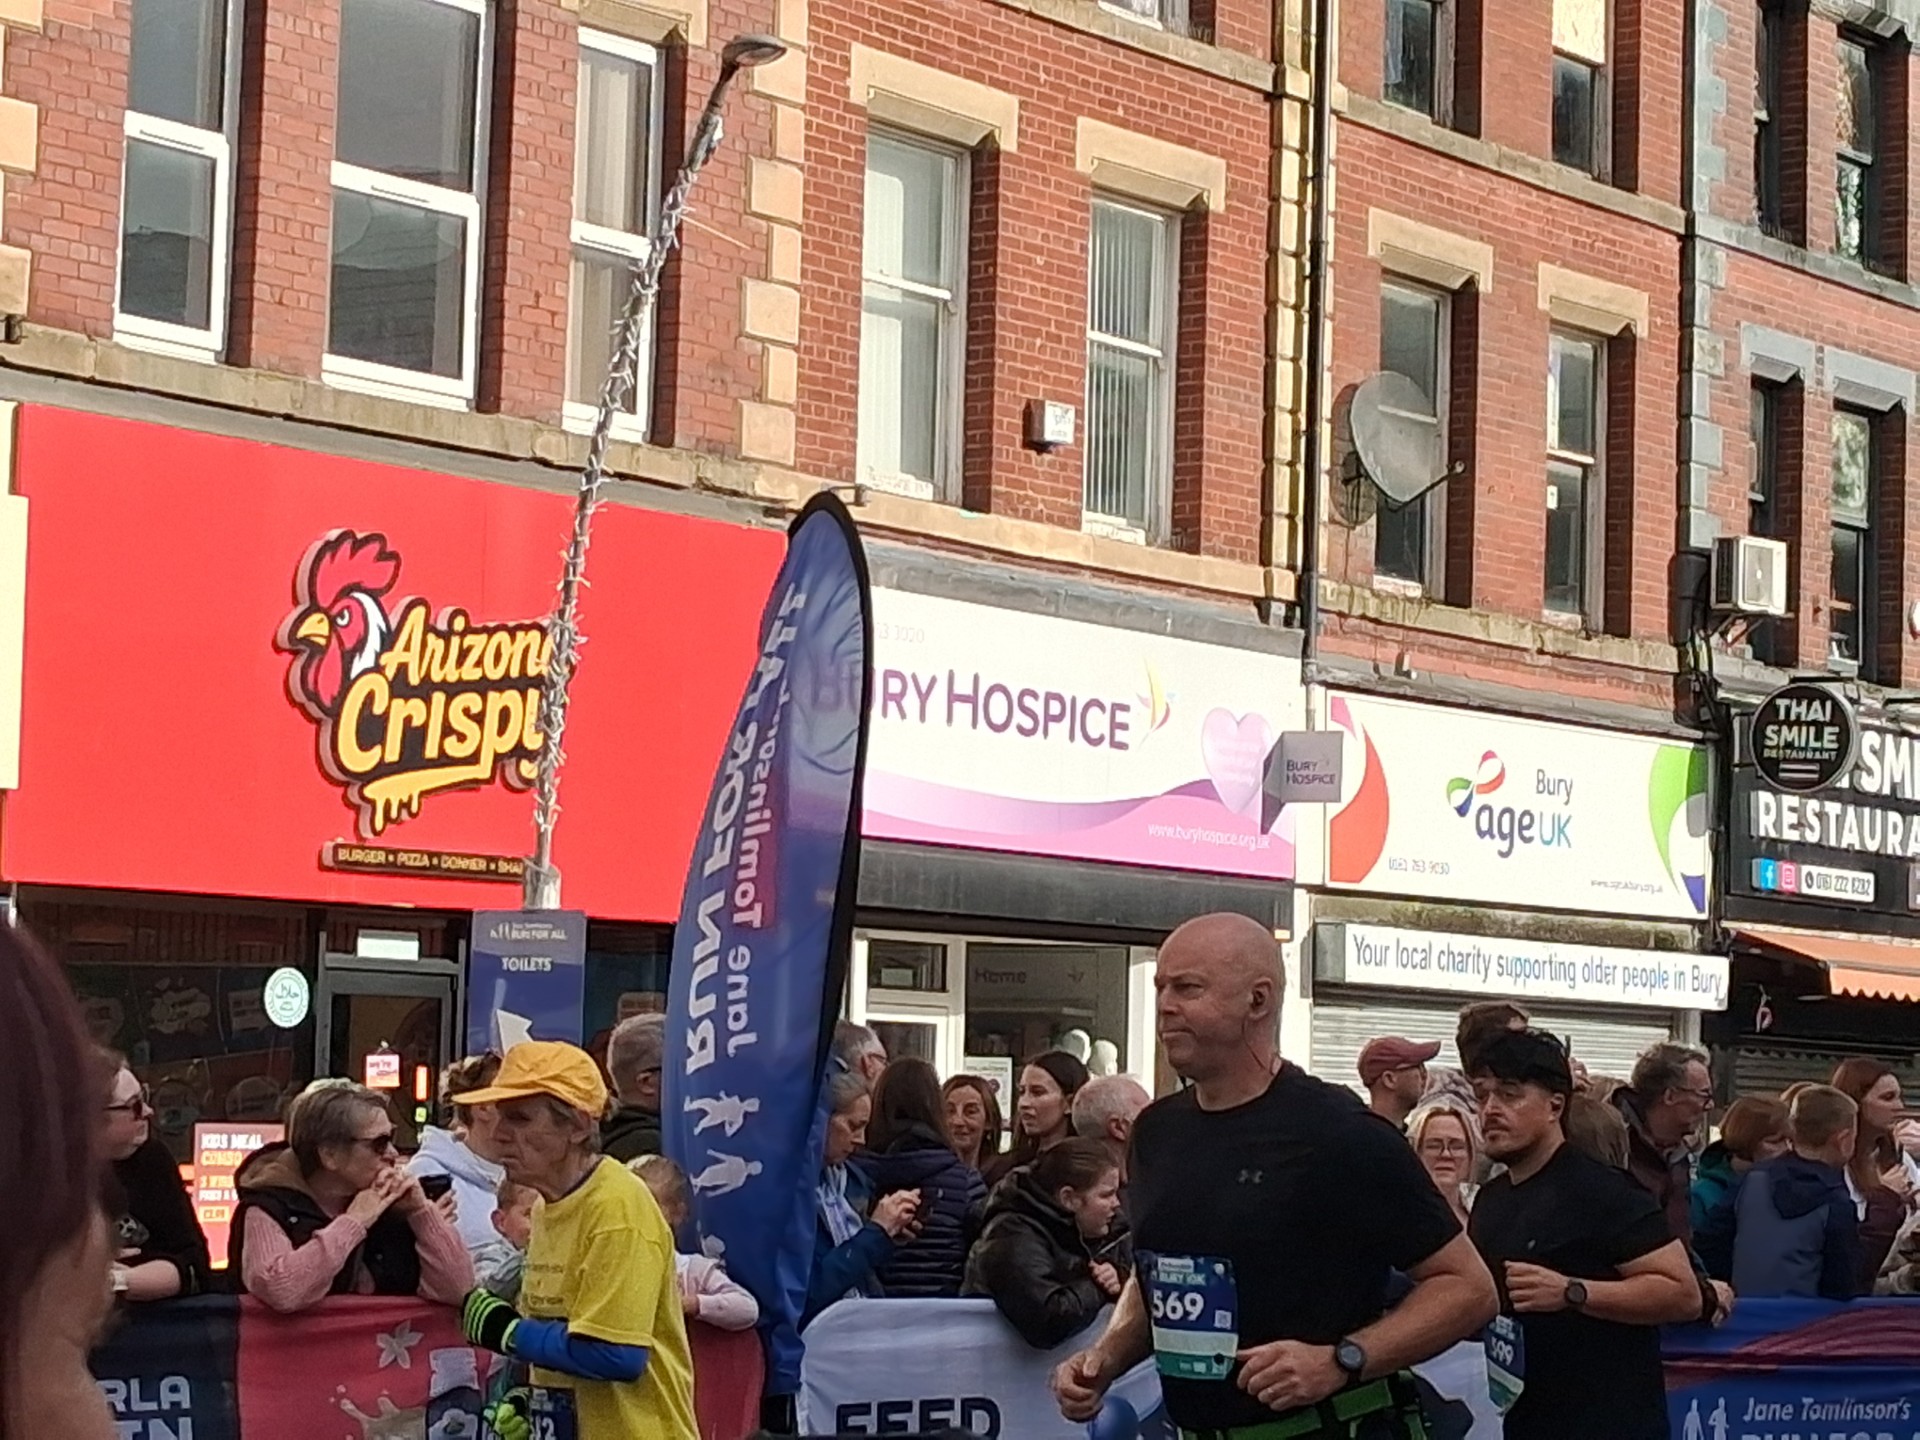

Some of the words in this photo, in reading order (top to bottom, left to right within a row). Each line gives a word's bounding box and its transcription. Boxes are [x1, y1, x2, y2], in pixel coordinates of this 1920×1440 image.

[946, 668, 1131, 751] HOSPICE
[1775, 698, 1832, 722] THAI
[1764, 725, 1839, 749] SMILE
[1286, 760, 1318, 772] BURY
[1763, 749, 1838, 762] RESTAURANT
[1286, 773, 1337, 785] HOSPICE
[1536, 768, 1573, 806] Bury
[338, 848, 386, 864] BURGER
[397, 852, 430, 868] PIZZA
[501, 956, 553, 972] TOILETS
[1352, 935, 1390, 968] Your
[1396, 938, 1432, 970] local
[1438, 942, 1492, 983] charity
[1496, 948, 1577, 990] supporting
[1582, 956, 1618, 986] older
[1623, 963, 1670, 997] people
[1674, 966, 1686, 990] in
[1691, 965, 1722, 997] Bury
[1743, 1397, 1794, 1422] Jane
[1801, 1397, 1911, 1422] Tomlinson's
